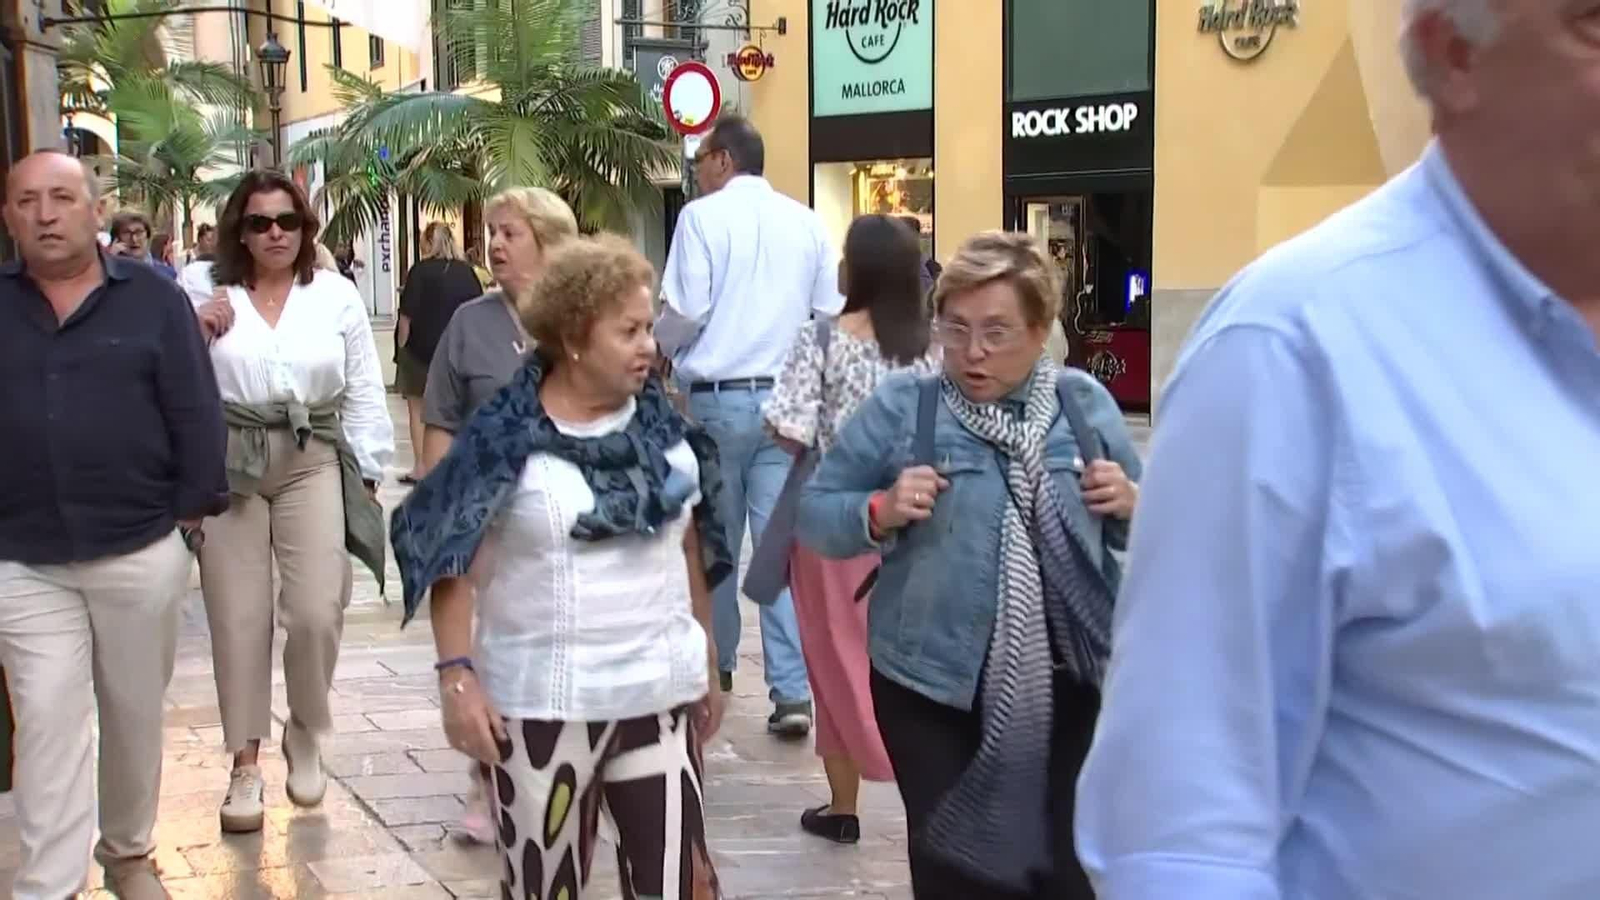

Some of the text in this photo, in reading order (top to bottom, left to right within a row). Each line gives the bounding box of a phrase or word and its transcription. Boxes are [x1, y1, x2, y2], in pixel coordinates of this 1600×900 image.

[826, 0, 919, 29] Hard Rock
[861, 34, 885, 48] CAFE
[841, 78, 906, 99] MALLORCA
[1011, 102, 1138, 138] ROCK SHOP
